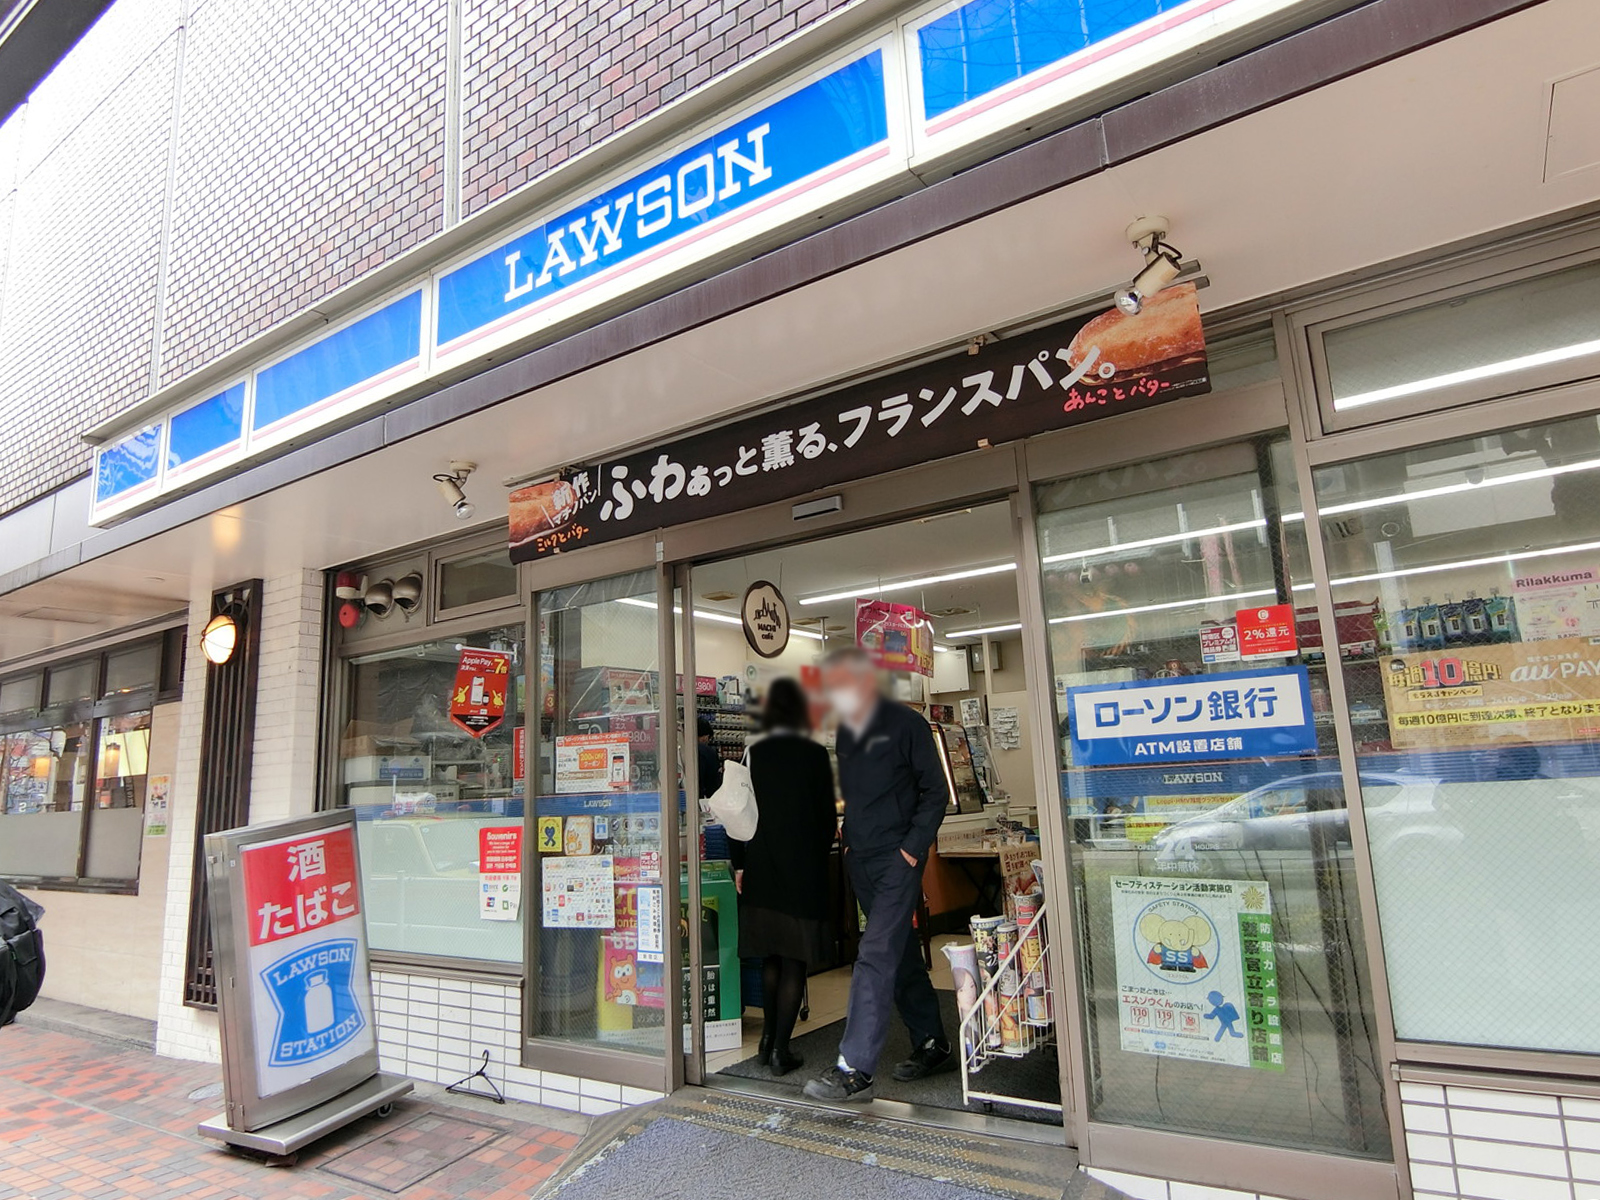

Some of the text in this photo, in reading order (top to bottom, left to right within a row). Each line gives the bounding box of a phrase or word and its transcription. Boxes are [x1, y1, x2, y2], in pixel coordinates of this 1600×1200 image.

[504, 122, 773, 302] LAWSON
[1515, 571, 1593, 588] Rilakkuma
[1094, 686, 1279, 728] ローソン銀行
[1134, 736, 1243, 757] ATM設置店舗
[1162, 772, 1223, 785] LAWSON
[286, 840, 327, 882] 酒
[1114, 879, 1233, 894] セーフティステーション活動実施店
[258, 881, 356, 940] たばこ
[1147, 901, 1199, 916] SAFETY STATION
[273, 947, 351, 986] LAWSON
[1165, 951, 1189, 963] SS
[1132, 1007, 1147, 1017] 110
[1156, 1010, 1172, 1021] 119
[279, 1013, 359, 1058] STATION
